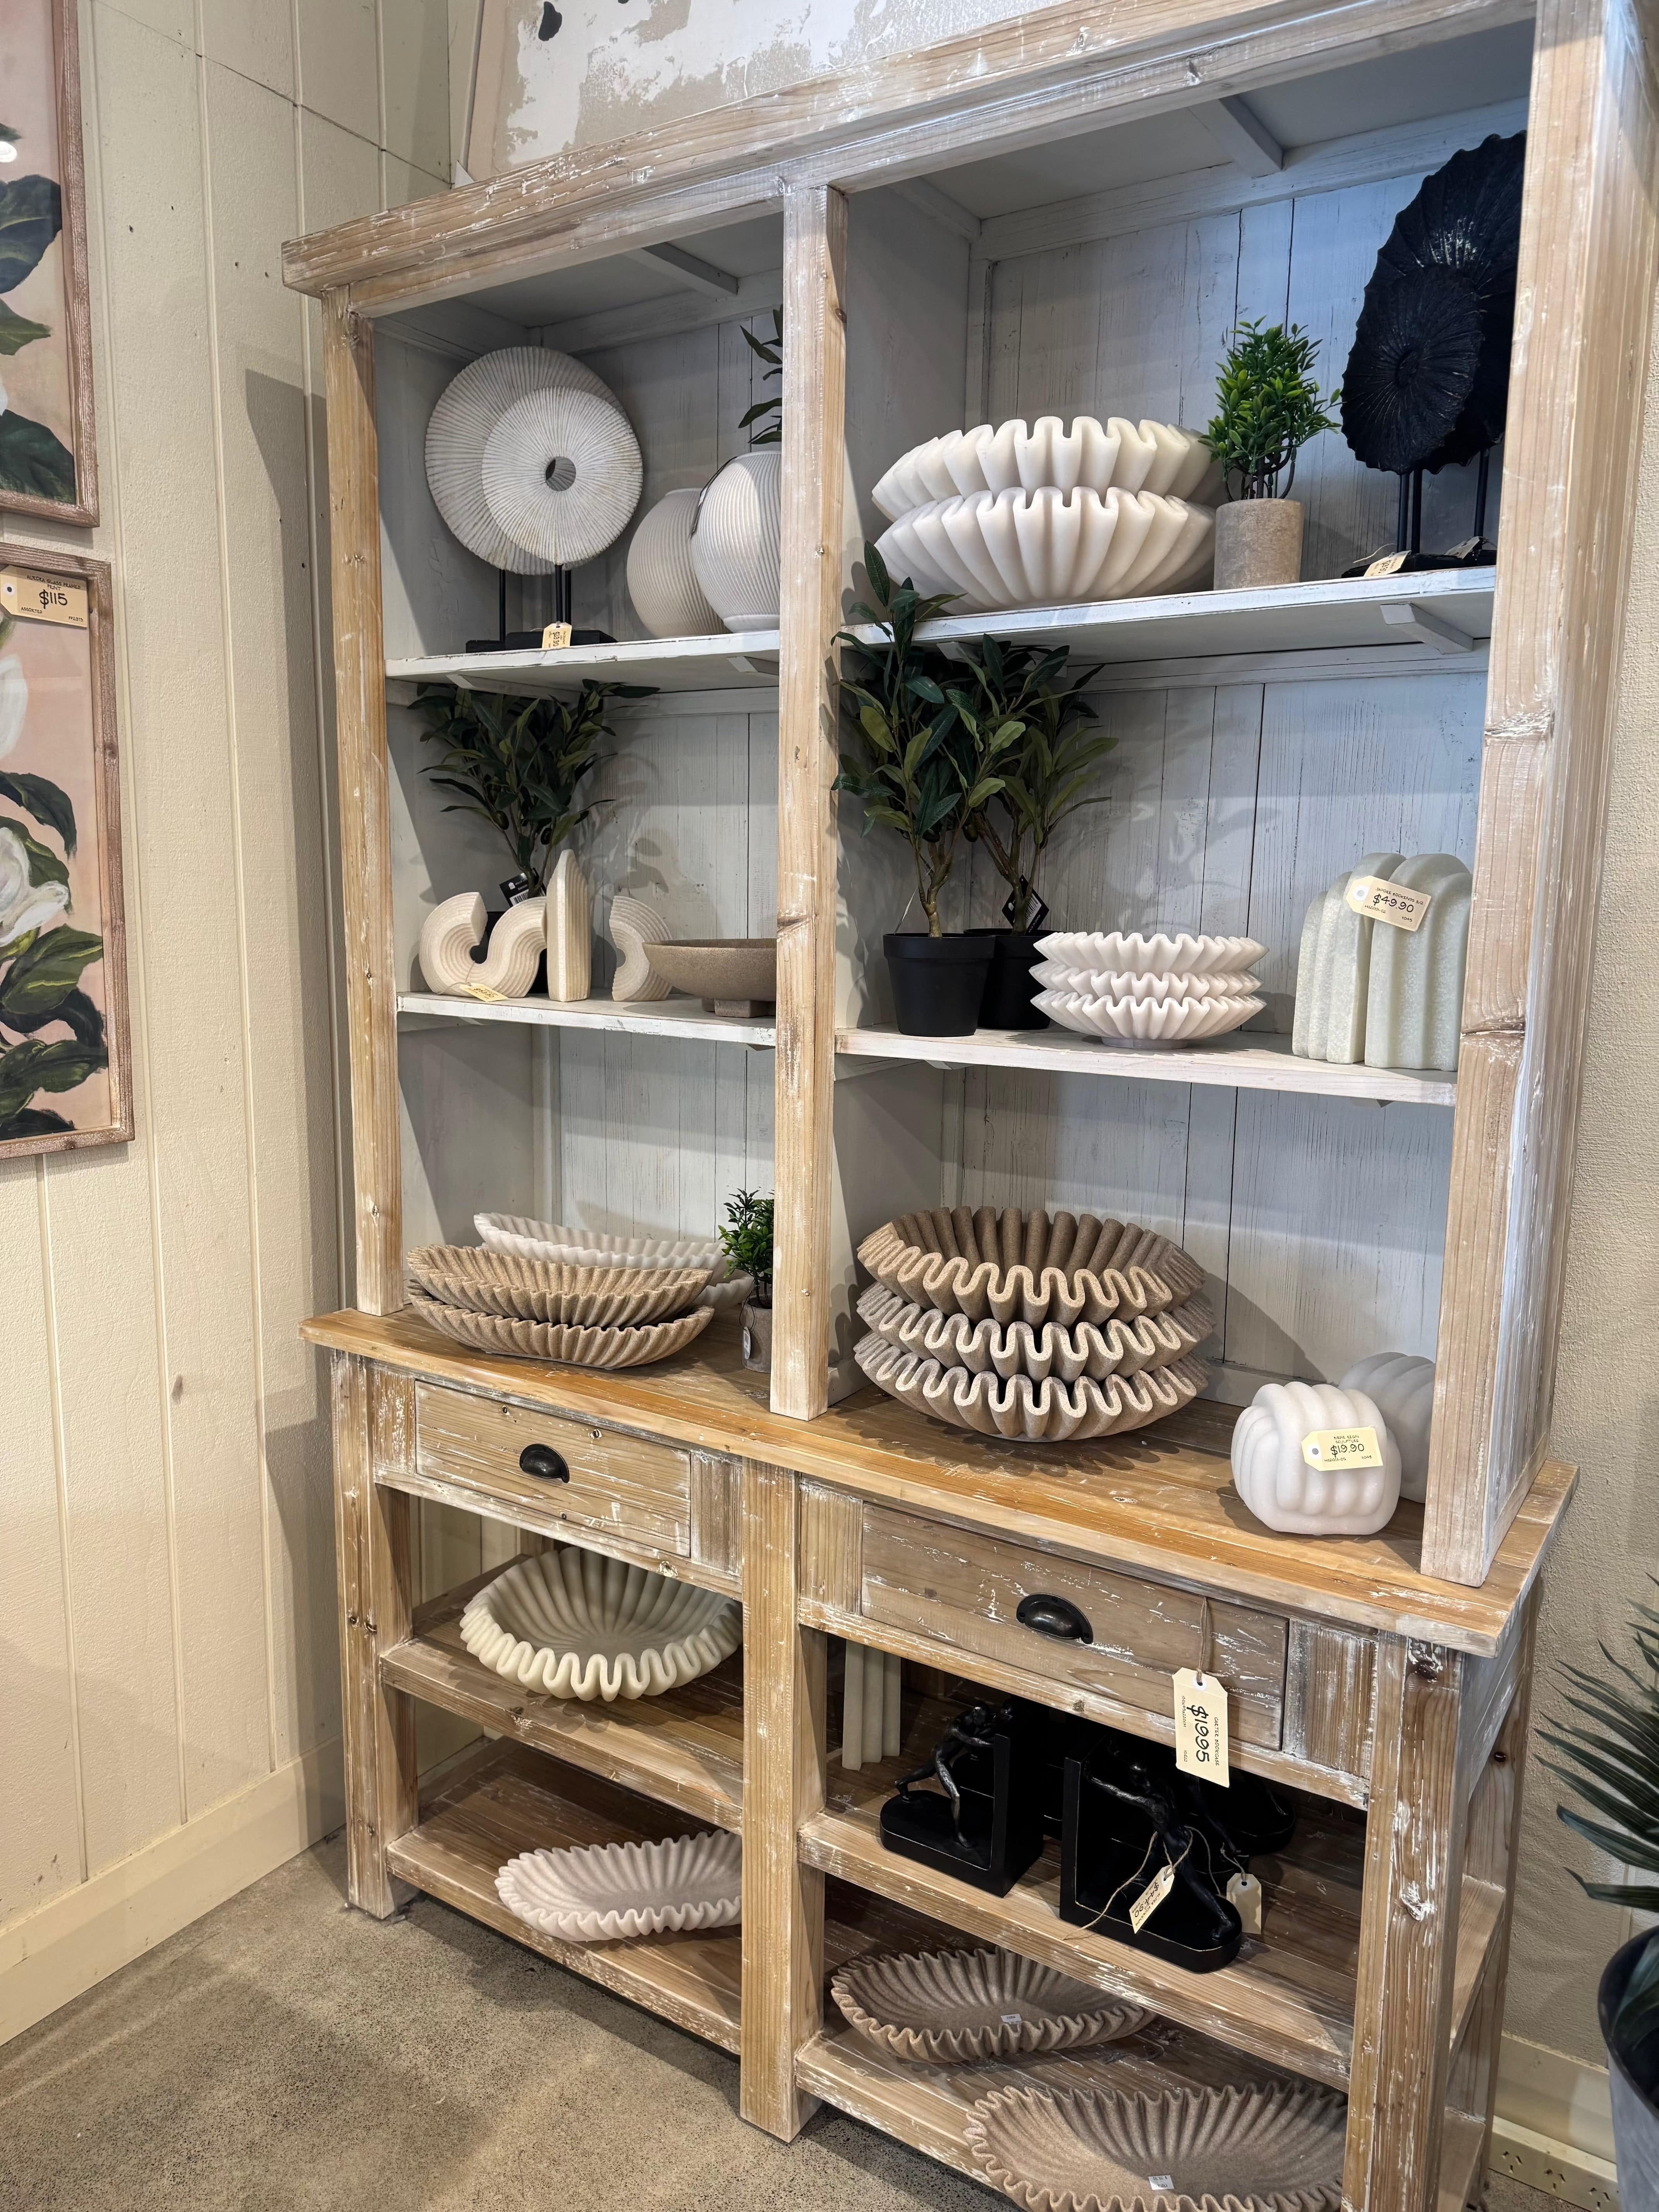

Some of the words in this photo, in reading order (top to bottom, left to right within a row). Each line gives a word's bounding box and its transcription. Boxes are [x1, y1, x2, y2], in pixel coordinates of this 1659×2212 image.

[39, 589, 68, 609] $115
[1373, 893, 1414, 912] $49.90
[1393, 893, 1415, 902] BOOKENDS
[1330, 1444, 1364, 1458] $19.90
[1187, 1705, 1210, 1762] $1995
[1135, 1880, 1159, 1917] $44.90
